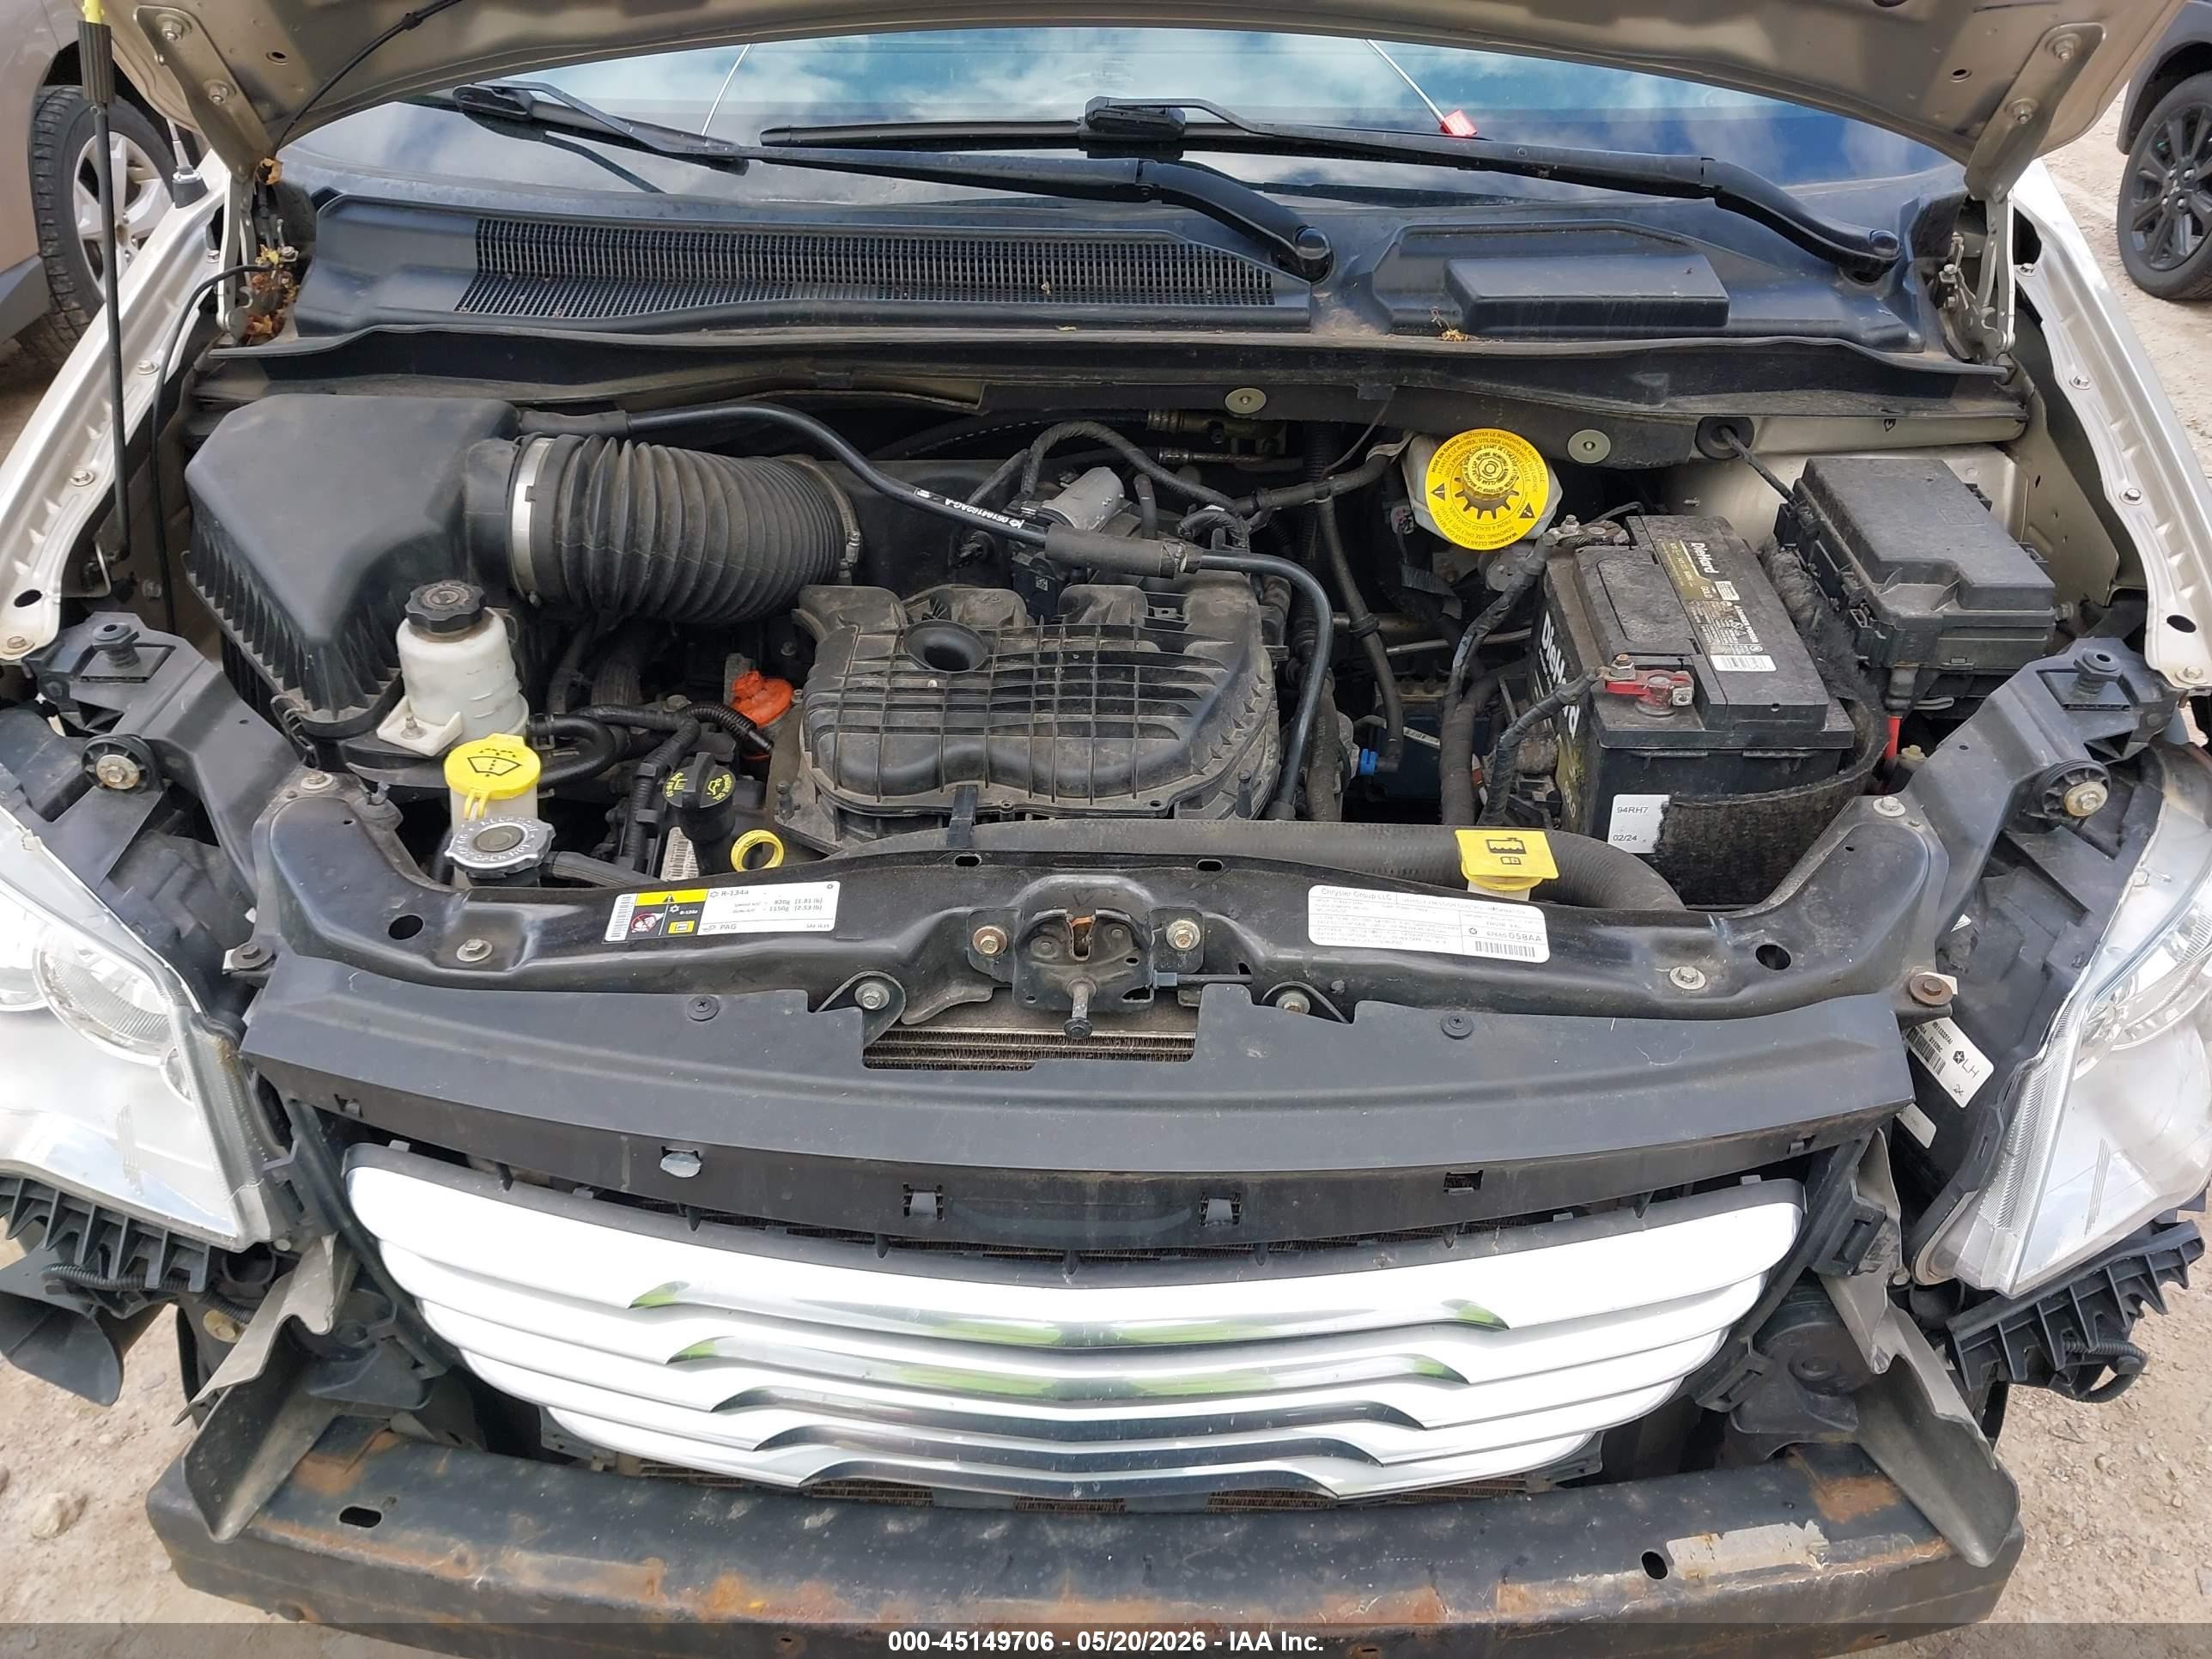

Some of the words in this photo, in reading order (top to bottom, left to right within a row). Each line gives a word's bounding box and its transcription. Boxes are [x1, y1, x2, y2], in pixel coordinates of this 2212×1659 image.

[1690, 542, 1719, 574] DieHard
[1700, 586, 1714, 599] GOLD
[1322, 887, 1351, 897] Chrysler
[1353, 891, 1376, 900] Group
[1961, 1059, 1979, 1079] LH
